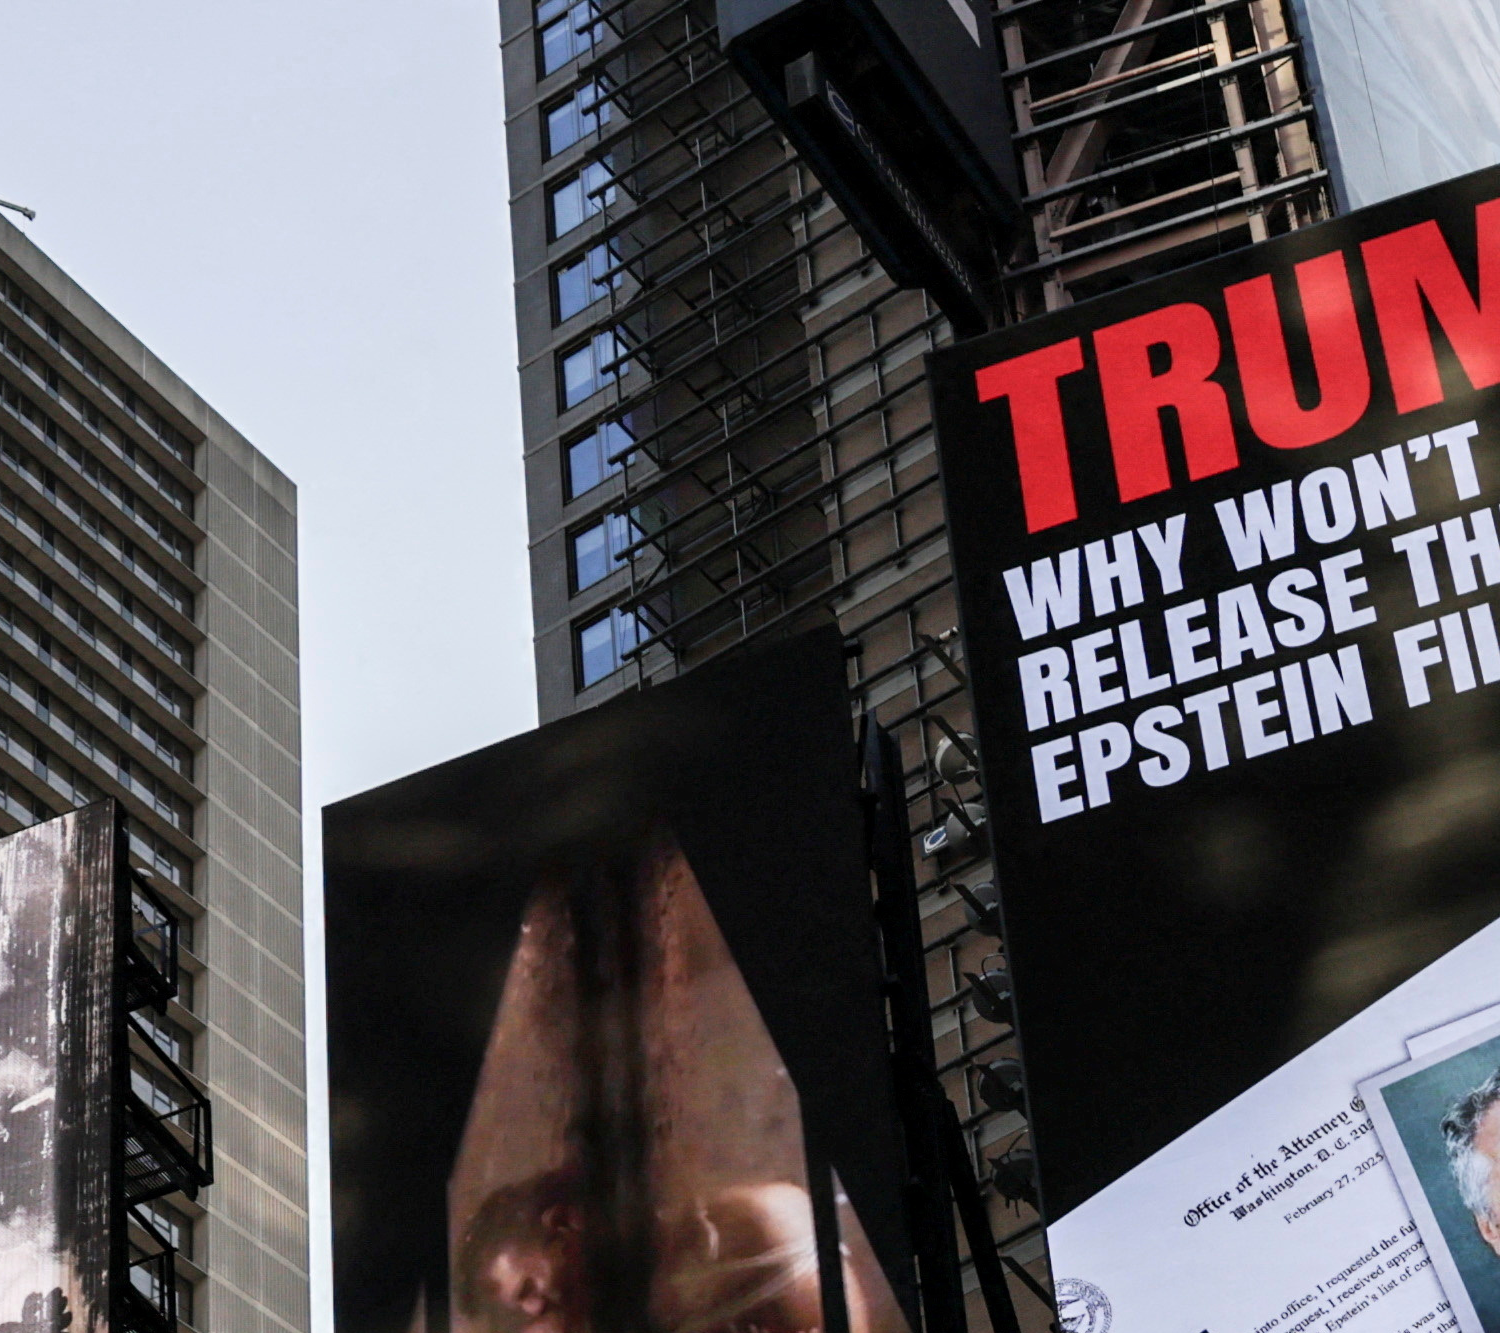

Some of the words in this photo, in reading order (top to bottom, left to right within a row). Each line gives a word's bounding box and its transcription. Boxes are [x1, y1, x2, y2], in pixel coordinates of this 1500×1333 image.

[1003, 514, 1187, 641] WHY
[1018, 548, 1376, 732] RELEASE
[1031, 644, 1372, 823] EPSTEIN
[1184, 1191, 1232, 1227] Office
[1236, 1174, 1253, 1196] of
[1254, 1158, 1278, 1187] the
[1279, 1107, 1354, 1162] Attorney
[1231, 1158, 1320, 1222] Washington,
[1284, 1191, 1334, 1225] February
[1357, 1151, 1384, 1174] 2025
